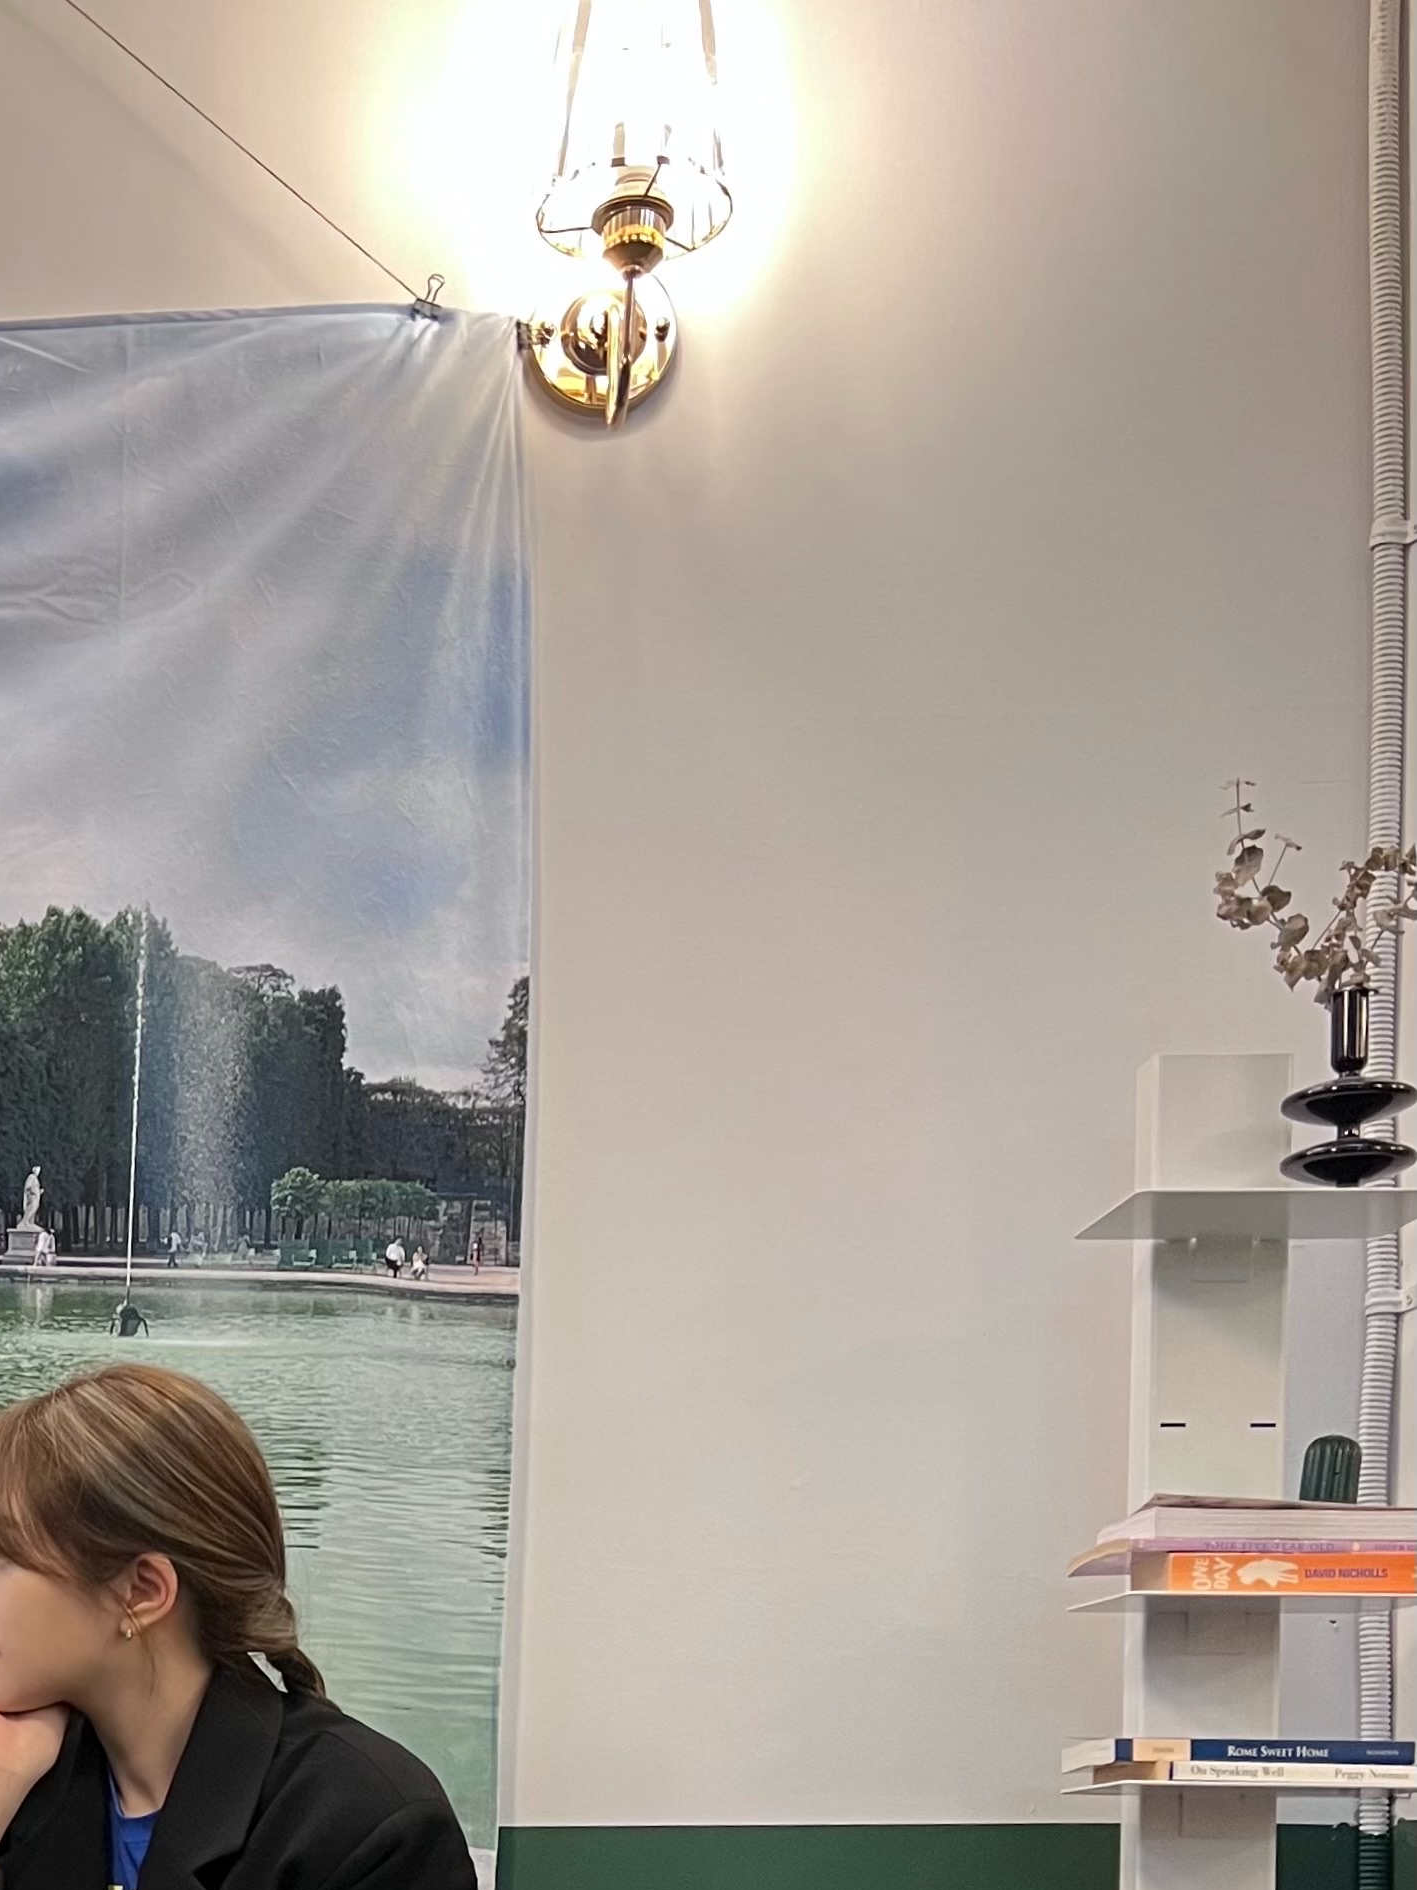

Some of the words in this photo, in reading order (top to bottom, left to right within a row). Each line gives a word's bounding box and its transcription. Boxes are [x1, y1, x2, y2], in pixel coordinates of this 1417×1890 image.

[1192, 1558, 1212, 1590] ONE
[1213, 1557, 1234, 1590] DAY
[1305, 1568, 1336, 1579] DAVID
[1338, 1568, 1388, 1579] NICHOLLS
[1227, 1745, 1258, 1758] ROME
[1260, 1745, 1294, 1758] SWEET
[1296, 1745, 1329, 1758] HOME
[1191, 1765, 1207, 1776] On
[1209, 1766, 1259, 1778] Speaking
[1262, 1766, 1284, 1777] Well
